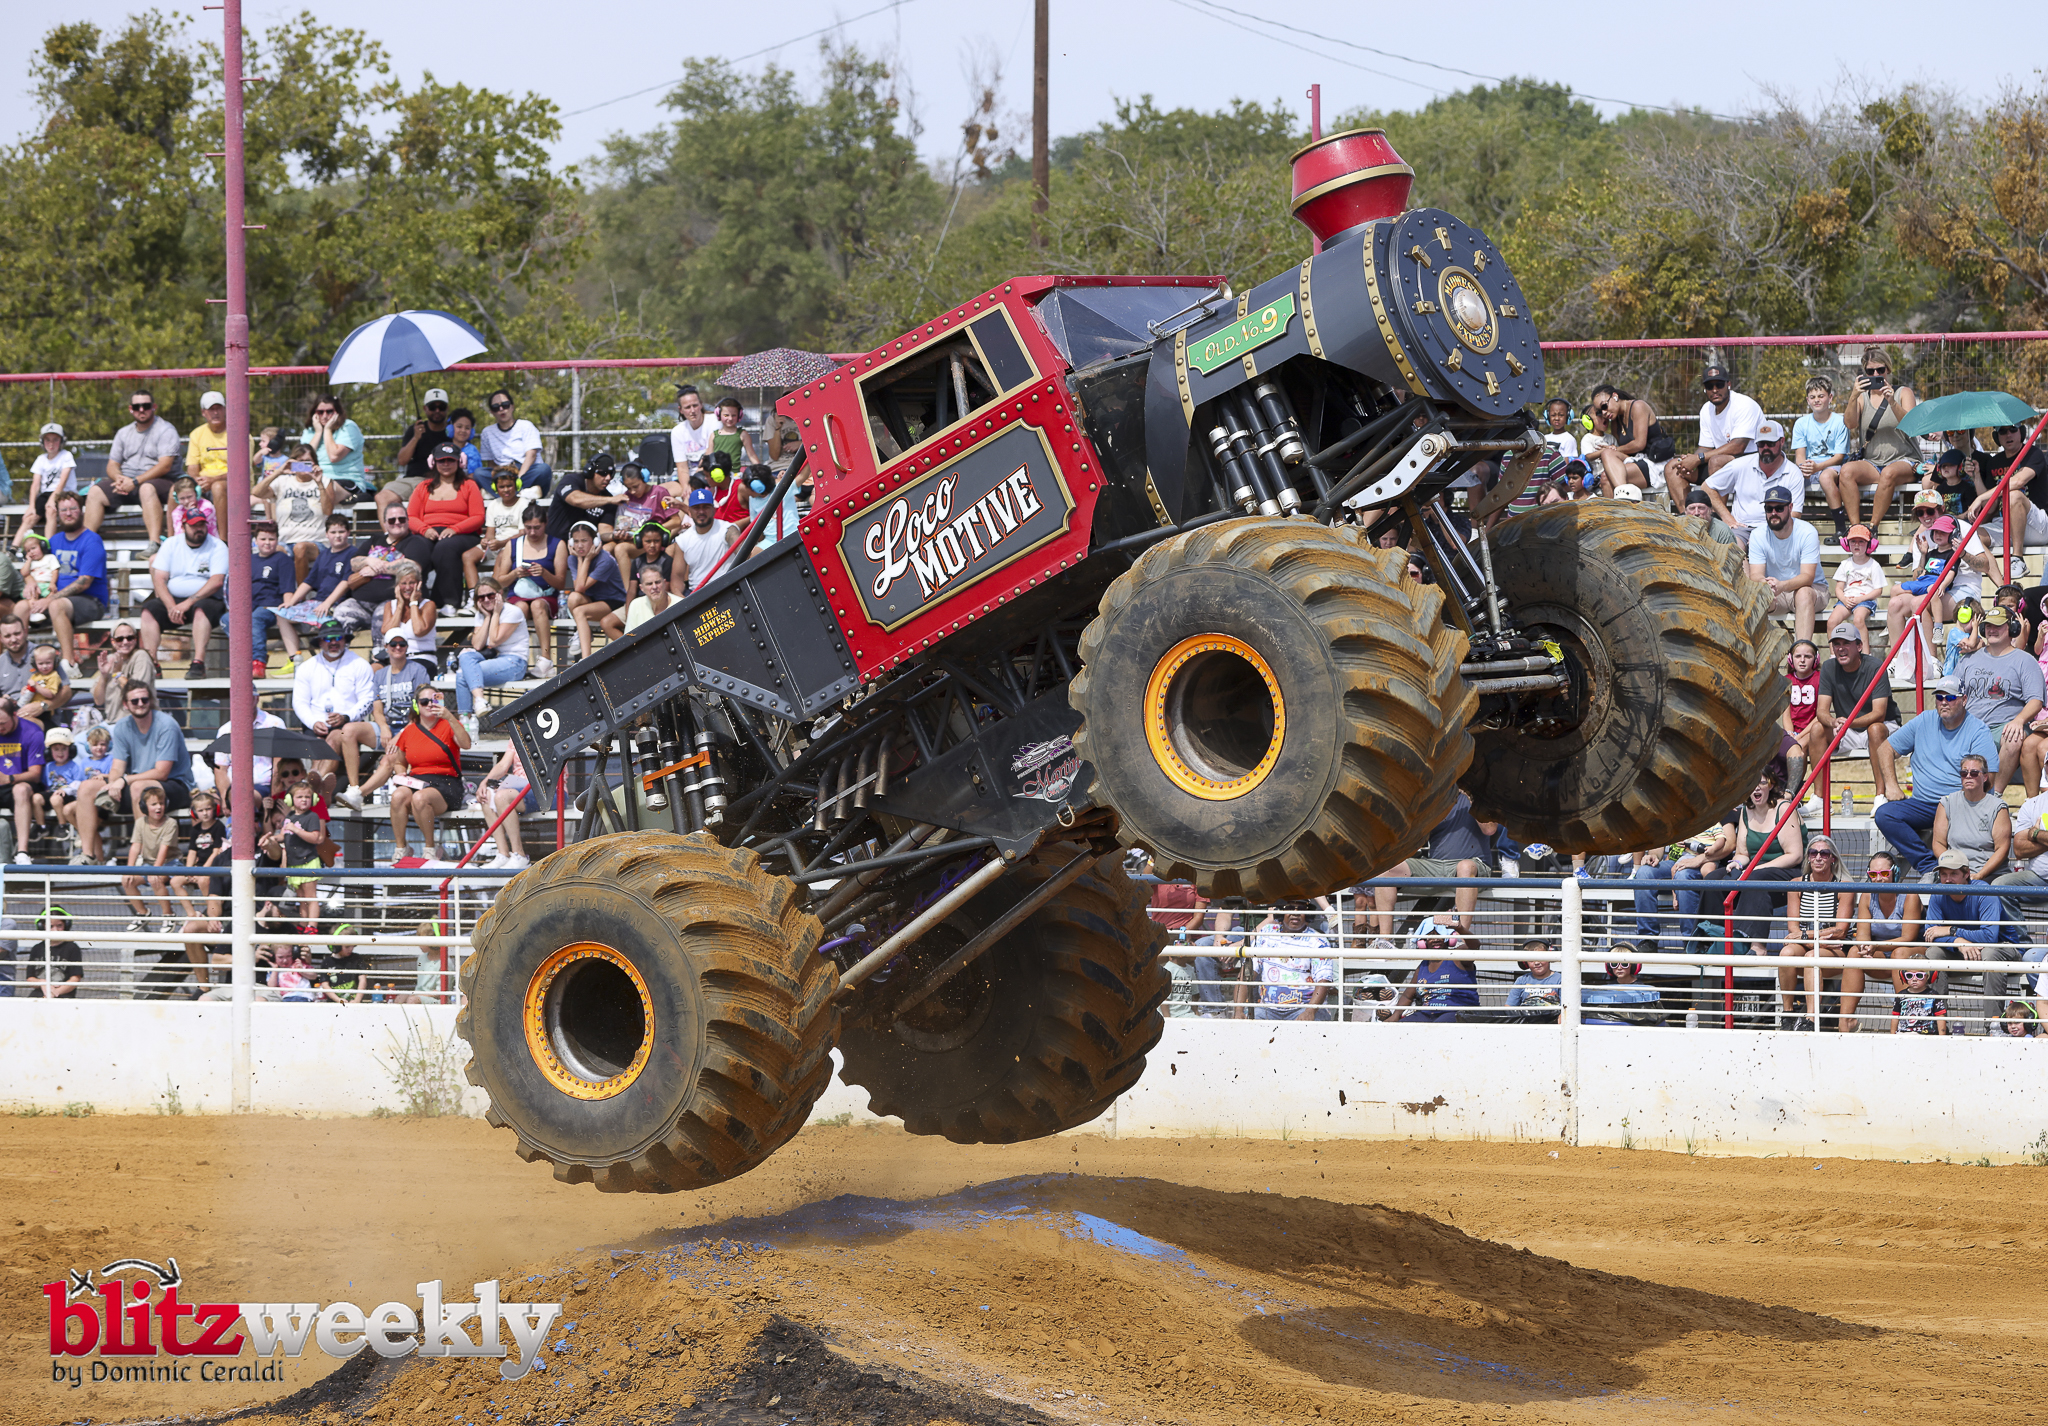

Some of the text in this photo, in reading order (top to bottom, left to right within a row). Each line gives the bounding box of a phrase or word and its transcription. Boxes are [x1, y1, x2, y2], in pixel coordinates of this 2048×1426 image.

[1205, 336, 1236, 362] OLD
[909, 462, 1045, 602] MOTIVE
[692, 609, 733, 639] MIDWEST
[699, 606, 719, 624] THE
[696, 618, 736, 648] EXPRESS
[379, 681, 413, 695] COBOYS
[536, 708, 560, 740] 9
[1023, 757, 1081, 797] Martin
[543, 895, 644, 931] FLOTATION
